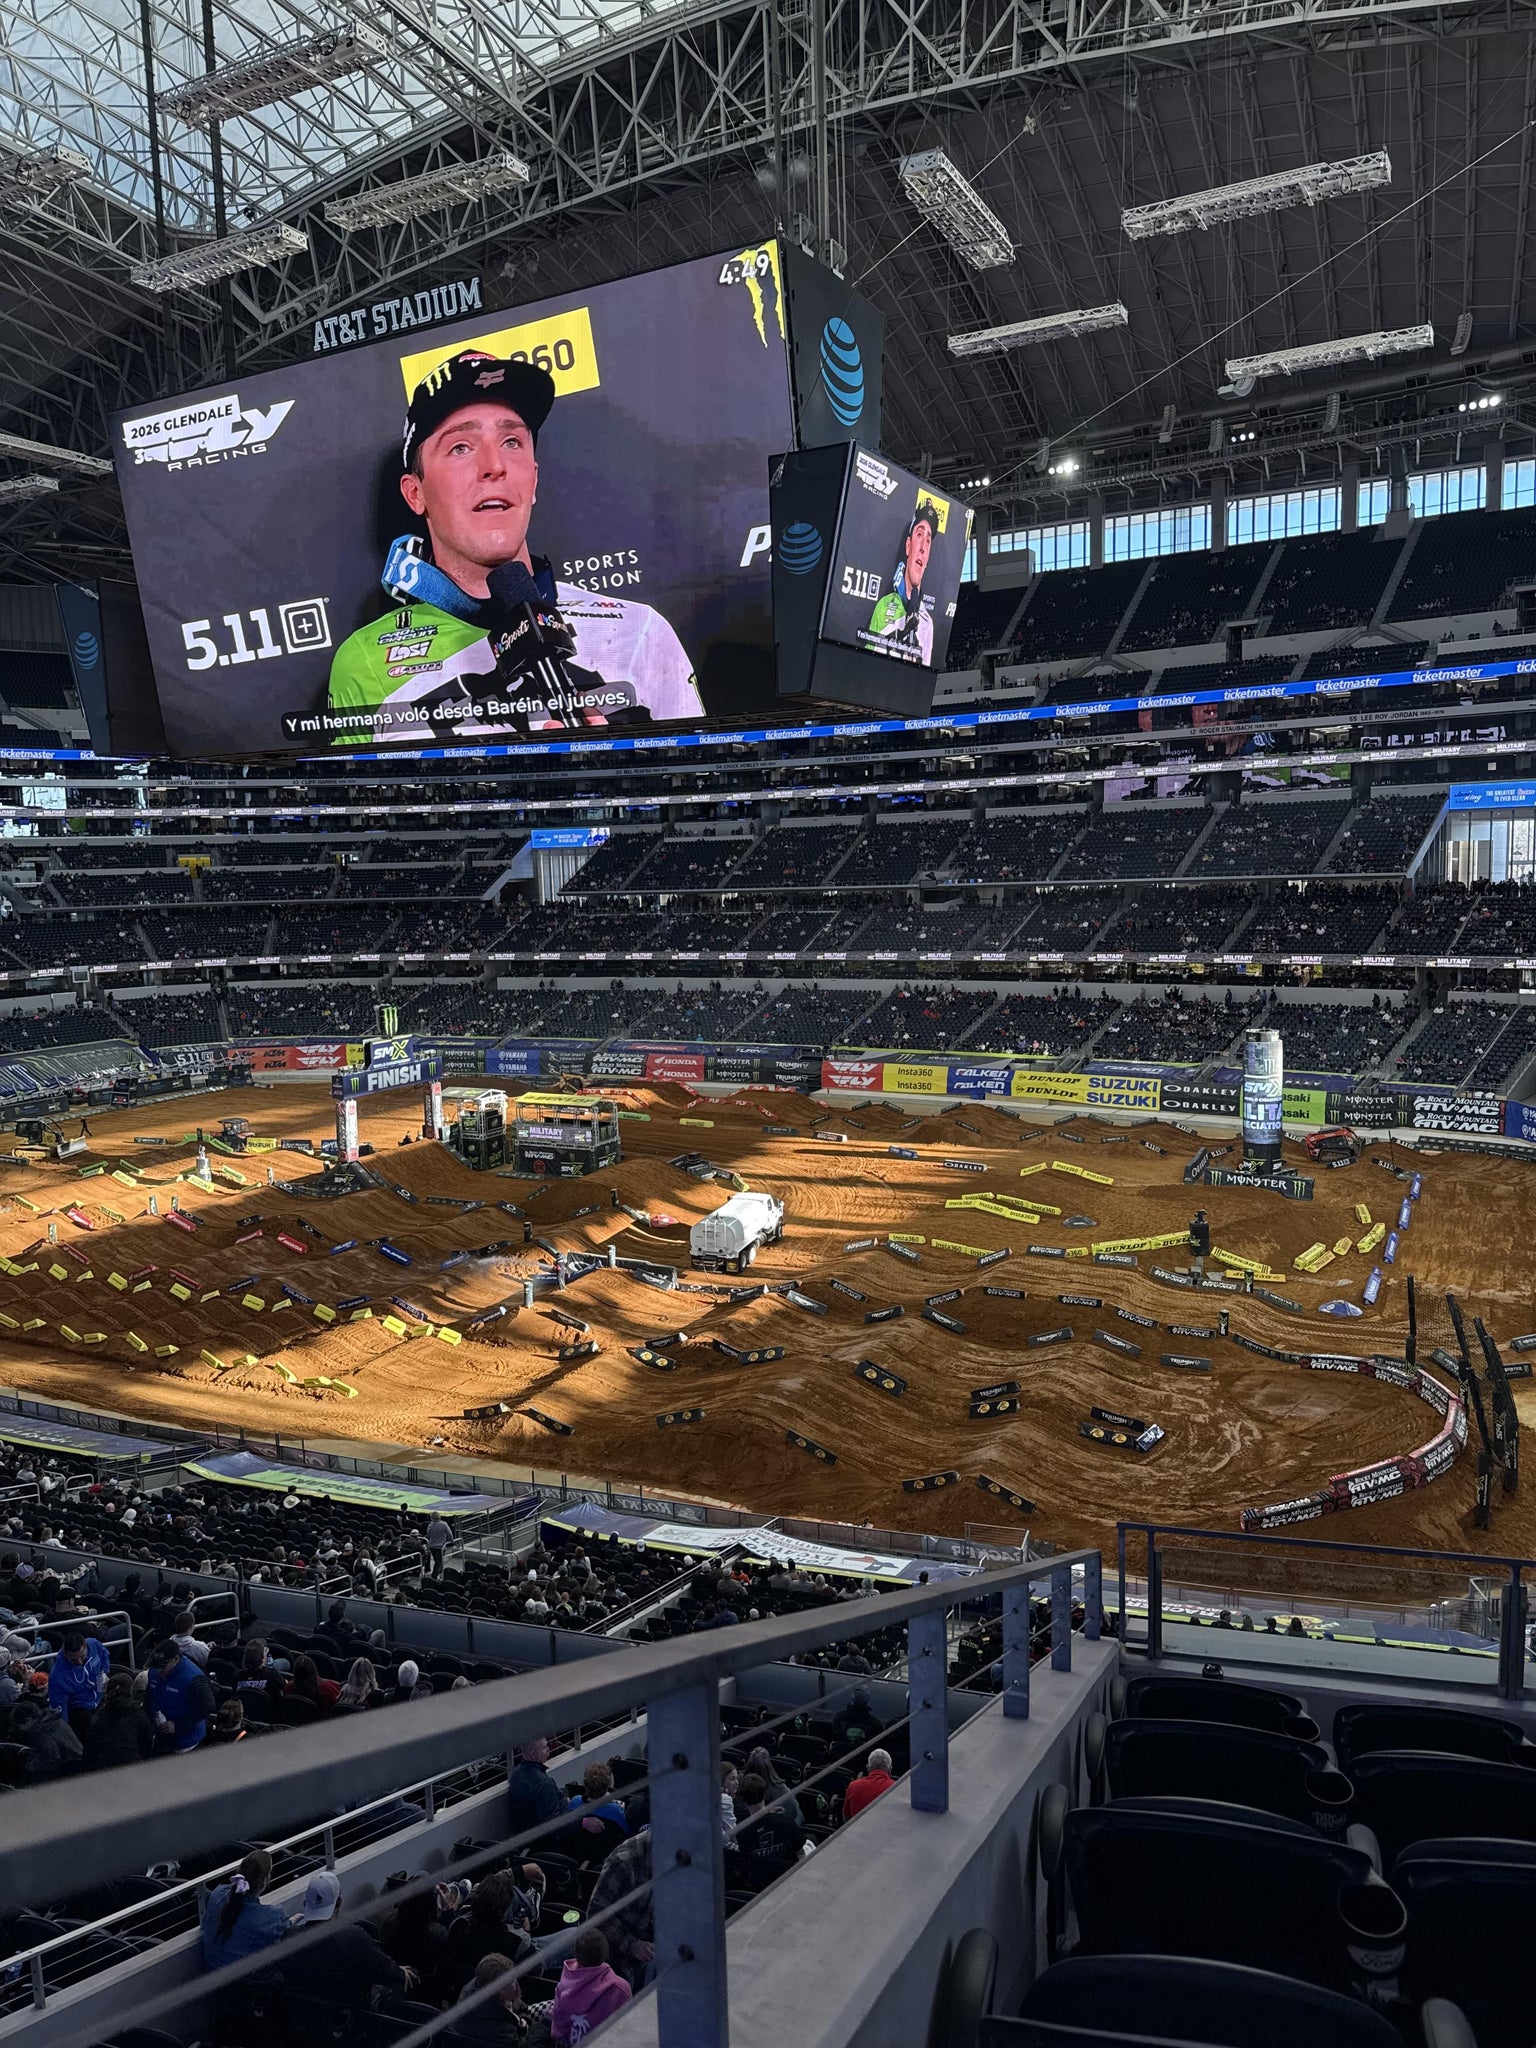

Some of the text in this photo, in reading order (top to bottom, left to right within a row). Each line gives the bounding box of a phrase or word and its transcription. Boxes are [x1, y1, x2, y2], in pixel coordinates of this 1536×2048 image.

[719, 253, 769, 285] 4:49
[313, 276, 483, 351] AT&T STADIUM
[131, 404, 233, 439] 2026 GLENDALE
[167, 442, 268, 472] RACING
[863, 483, 888, 500] RACING
[739, 524, 774, 568] P
[563, 549, 639, 576] SPORTS
[570, 569, 639, 591] SSION
[841, 566, 868, 599] 5.11
[181, 608, 283, 670] 5.11
[501, 619, 530, 650] Sports
[1412, 667, 1483, 683] ticketmaster
[1315, 677, 1382, 692] ticketmaster
[1223, 685, 1287, 701] ticketmaster
[1137, 695, 1197, 708] ticketmaster
[286, 691, 632, 733] Y mi hermana voló desde Baréin el jueves,
[1055, 703, 1112, 717] ticketmaster
[1361, 713, 1373, 721] LEE
[1375, 713, 1389, 721] ROY
[1390, 710, 1419, 720] JORDAN
[977, 710, 1031, 724] ticketmaster
[904, 717, 955, 729] ticketmaster
[765, 728, 812, 740] ticketmaster
[833, 723, 882, 735] ticketmaster
[1199, 726, 1220, 735] ROGER
[1221, 723, 1253, 734] STAUBACH
[633, 738, 679, 748] ticketmaster
[699, 733, 745, 744] ticketmaster
[1078, 736, 1104, 745] PERKINS
[506, 745, 550, 755] ticketmaster
[569, 741, 614, 752] ticketmaster
[1432, 747, 1461, 755] MILITARY
[1497, 742, 1527, 750] MILITARY
[376, 750, 423, 760] ticketmaster
[444, 747, 487, 758] ticketmaster
[1370, 751, 1398, 759] MILITARY
[844, 755, 870, 763] MEREDITH
[1291, 955, 1323, 963] MILITARY
[1362, 957, 1396, 965] MILITARY
[1437, 958, 1472, 966] MILITARY
[39, 968, 65, 976] MILITARY
[263, 1049, 286, 1057] KTM
[296, 1044, 342, 1054] FLY
[373, 1040, 409, 1061] SMX
[296, 1056, 342, 1065] FLY
[505, 1051, 528, 1059] YAMAHA
[264, 1061, 287, 1069] KTM
[664, 1058, 698, 1066] HONDA
[775, 1061, 803, 1070] TRIUMPH
[829, 1062, 878, 1072] FLY
[505, 1064, 528, 1072] YAMAHA
[897, 1067, 933, 1077] Insta360
[956, 1068, 1009, 1078] FALKEN
[1103, 1065, 1164, 1073] FALKEN
[367, 1064, 422, 1092] FINISH
[663, 1071, 698, 1079] HONDA
[775, 1074, 802, 1083] TRIUMPH
[1027, 1075, 1082, 1085] DUNLOP
[828, 1075, 877, 1087] FLY
[897, 1081, 932, 1091] Insta360
[953, 1081, 1005, 1090] FALKEN
[1088, 1077, 1158, 1093] SUZUKI
[1025, 1087, 1080, 1098] DUNLOP
[1183, 1086, 1237, 1096] OAKLEY
[1086, 1092, 1157, 1108] SUZUKI
[1345, 1095, 1394, 1104] MONSTER
[1427, 1095, 1500, 1107] ROCKY MOUNTAIN
[1182, 1102, 1236, 1112] OAKLEY
[1344, 1112, 1393, 1121] MONSTER
[1426, 1112, 1499, 1124] ROCKY MOUNTAIN
[529, 1127, 563, 1136] MILITARY
[955, 1163, 983, 1171] OAKLEY
[1056, 1163, 1079, 1175] Insta360
[1085, 1172, 1110, 1182] Insta360
[1227, 1174, 1288, 1190] MONSTER
[1000, 1196, 1024, 1207] Insta360
[978, 1202, 1004, 1213] Insta360
[1031, 1205, 1056, 1214] Insta360
[1010, 1211, 1035, 1220] Insta360
[893, 1234, 920, 1243] Insta360
[936, 1242, 962, 1252] Insta360
[1105, 1242, 1148, 1253] DUNLOP
[871, 1310, 893, 1320] TRIUMPH
[932, 1315, 954, 1329] TRIUMPH
[1036, 1333, 1060, 1343] TRIUMPH
[1103, 1334, 1129, 1348] TRIUMPH
[1170, 1357, 1196, 1366] TRIUMPH
[979, 1386, 1003, 1398] TRIUMPH
[1102, 1411, 1129, 1425] TRIUMPH
[1354, 1466, 1398, 1484] ROCKY MOUNTAIN
[1271, 1504, 1322, 1521] ROCKY MOUNTAIN
